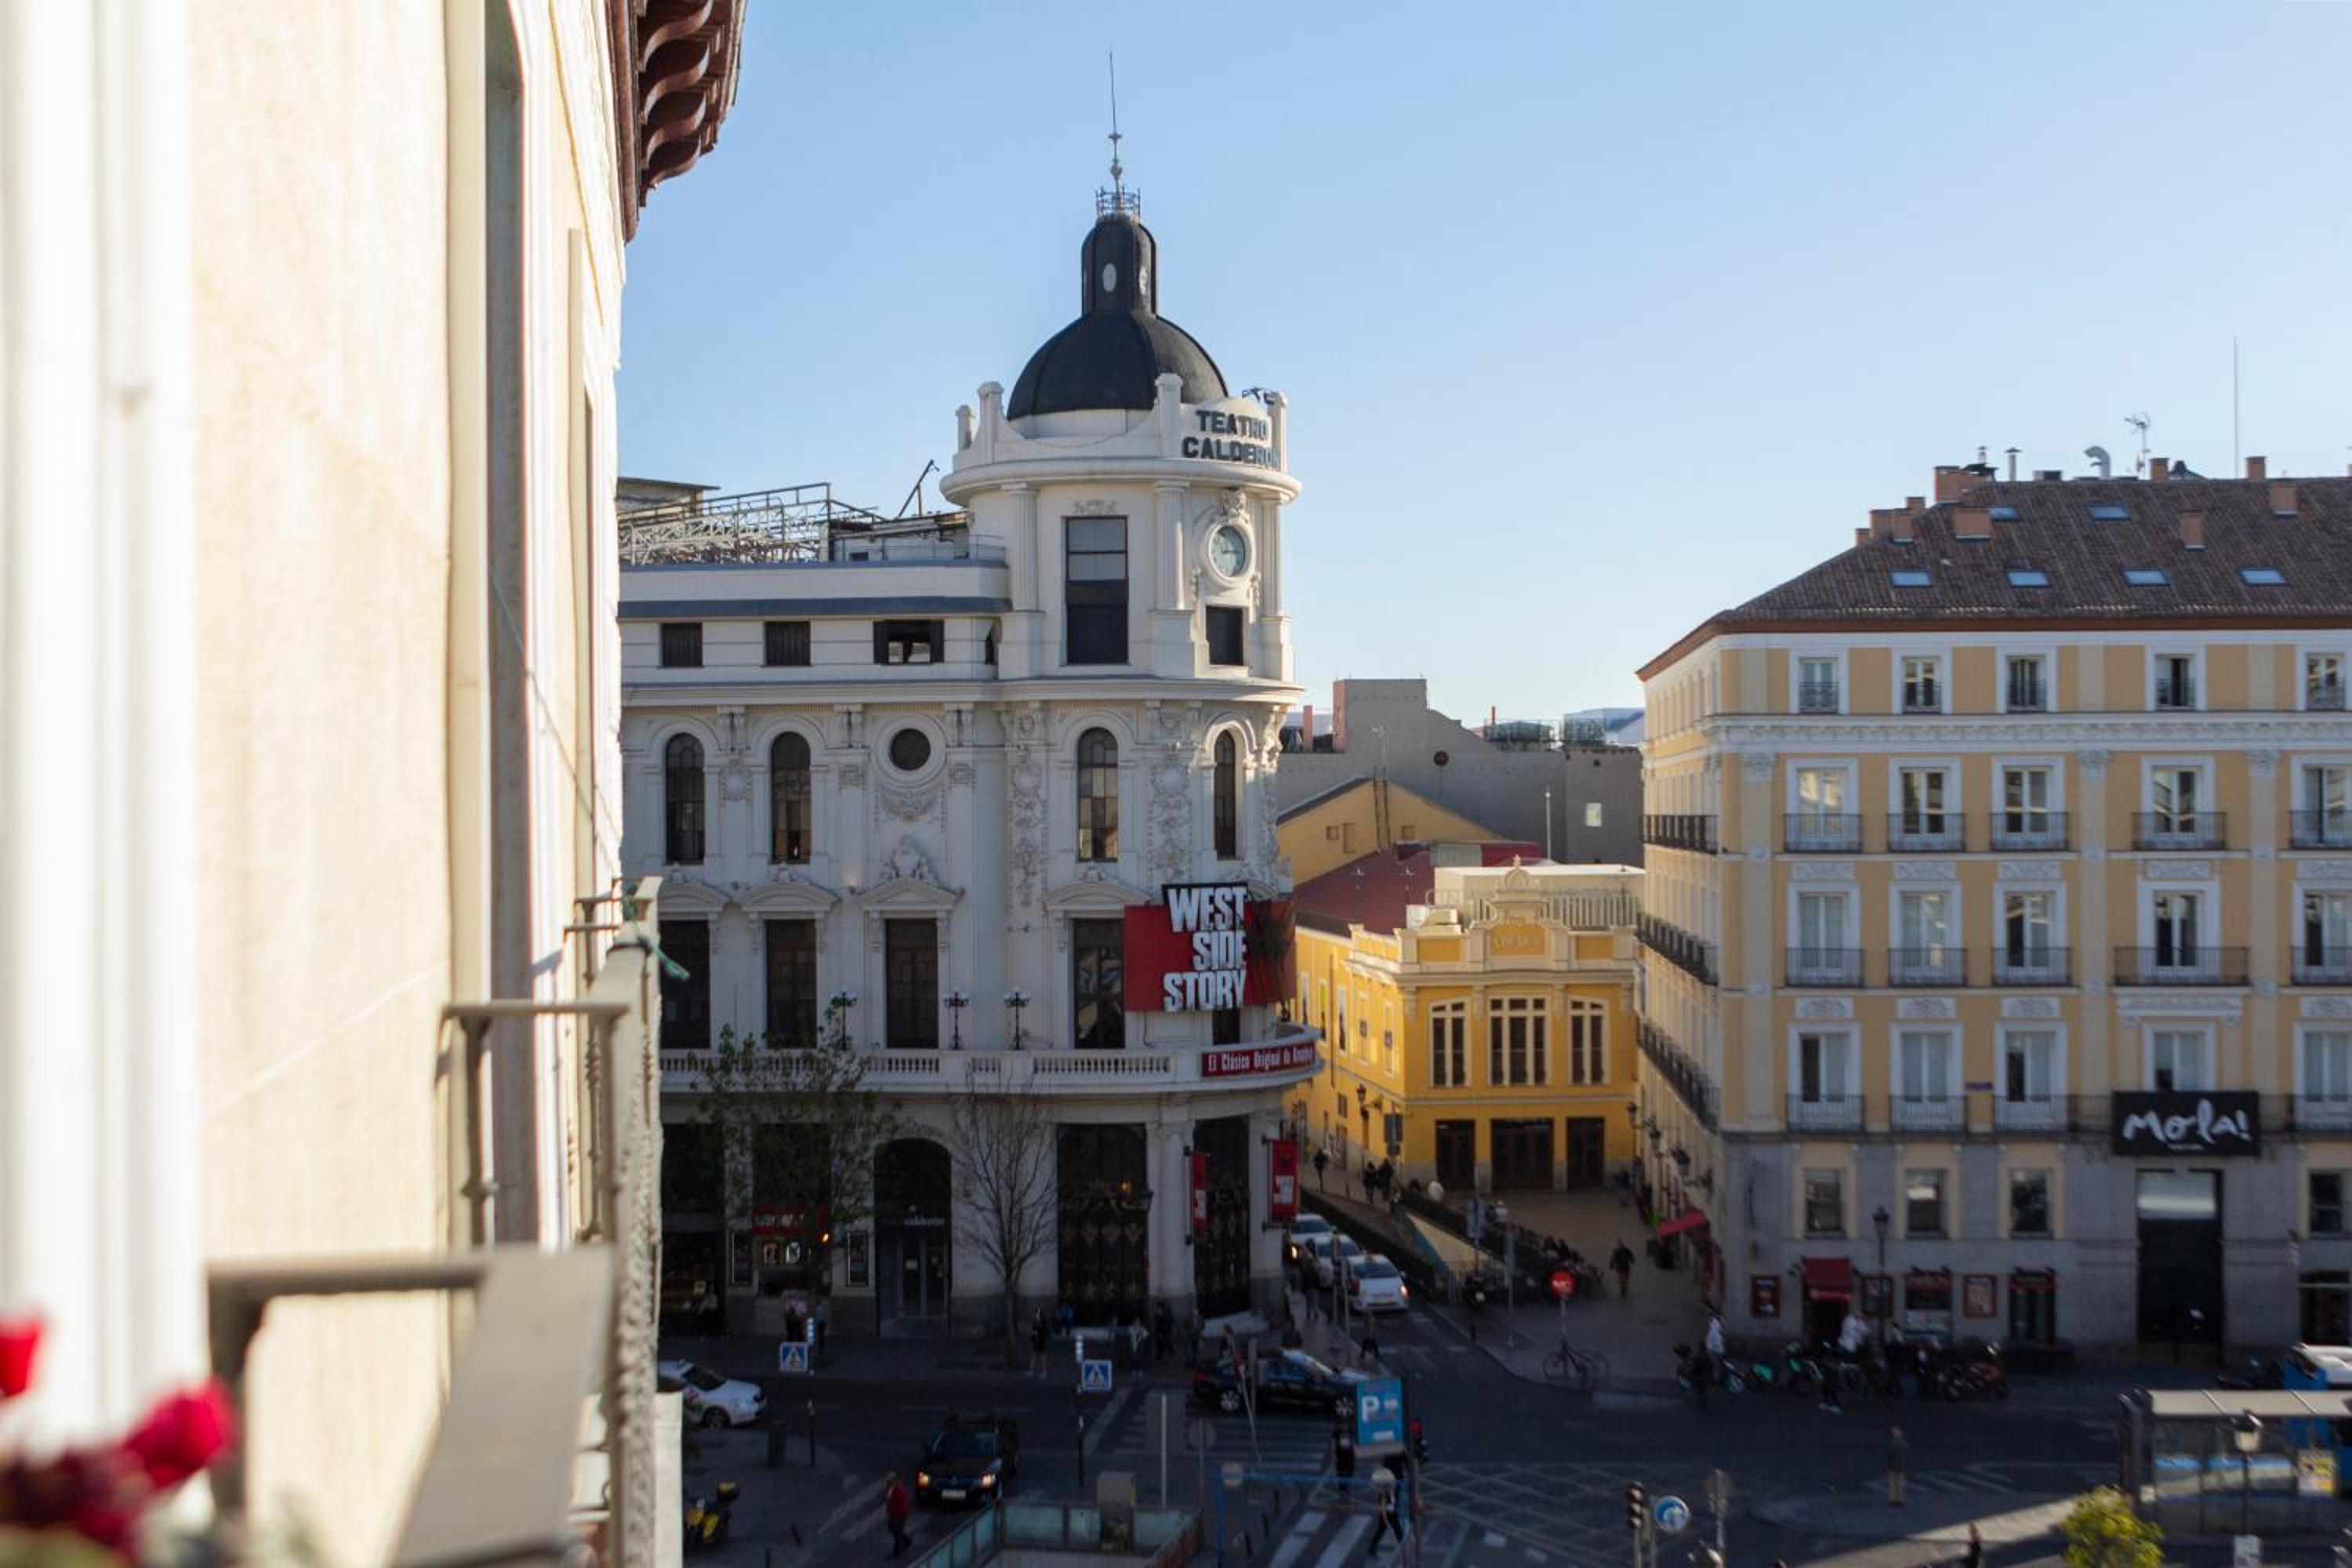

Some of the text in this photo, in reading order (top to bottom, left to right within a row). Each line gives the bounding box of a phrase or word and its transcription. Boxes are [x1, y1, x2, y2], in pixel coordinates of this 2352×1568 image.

[1196, 409, 1268, 441] TEATRO
[1167, 887, 1247, 932] WEST
[1192, 930, 1247, 971] SIDE
[1163, 970, 1247, 1012] STORY
[1361, 1396, 1380, 1423] P
